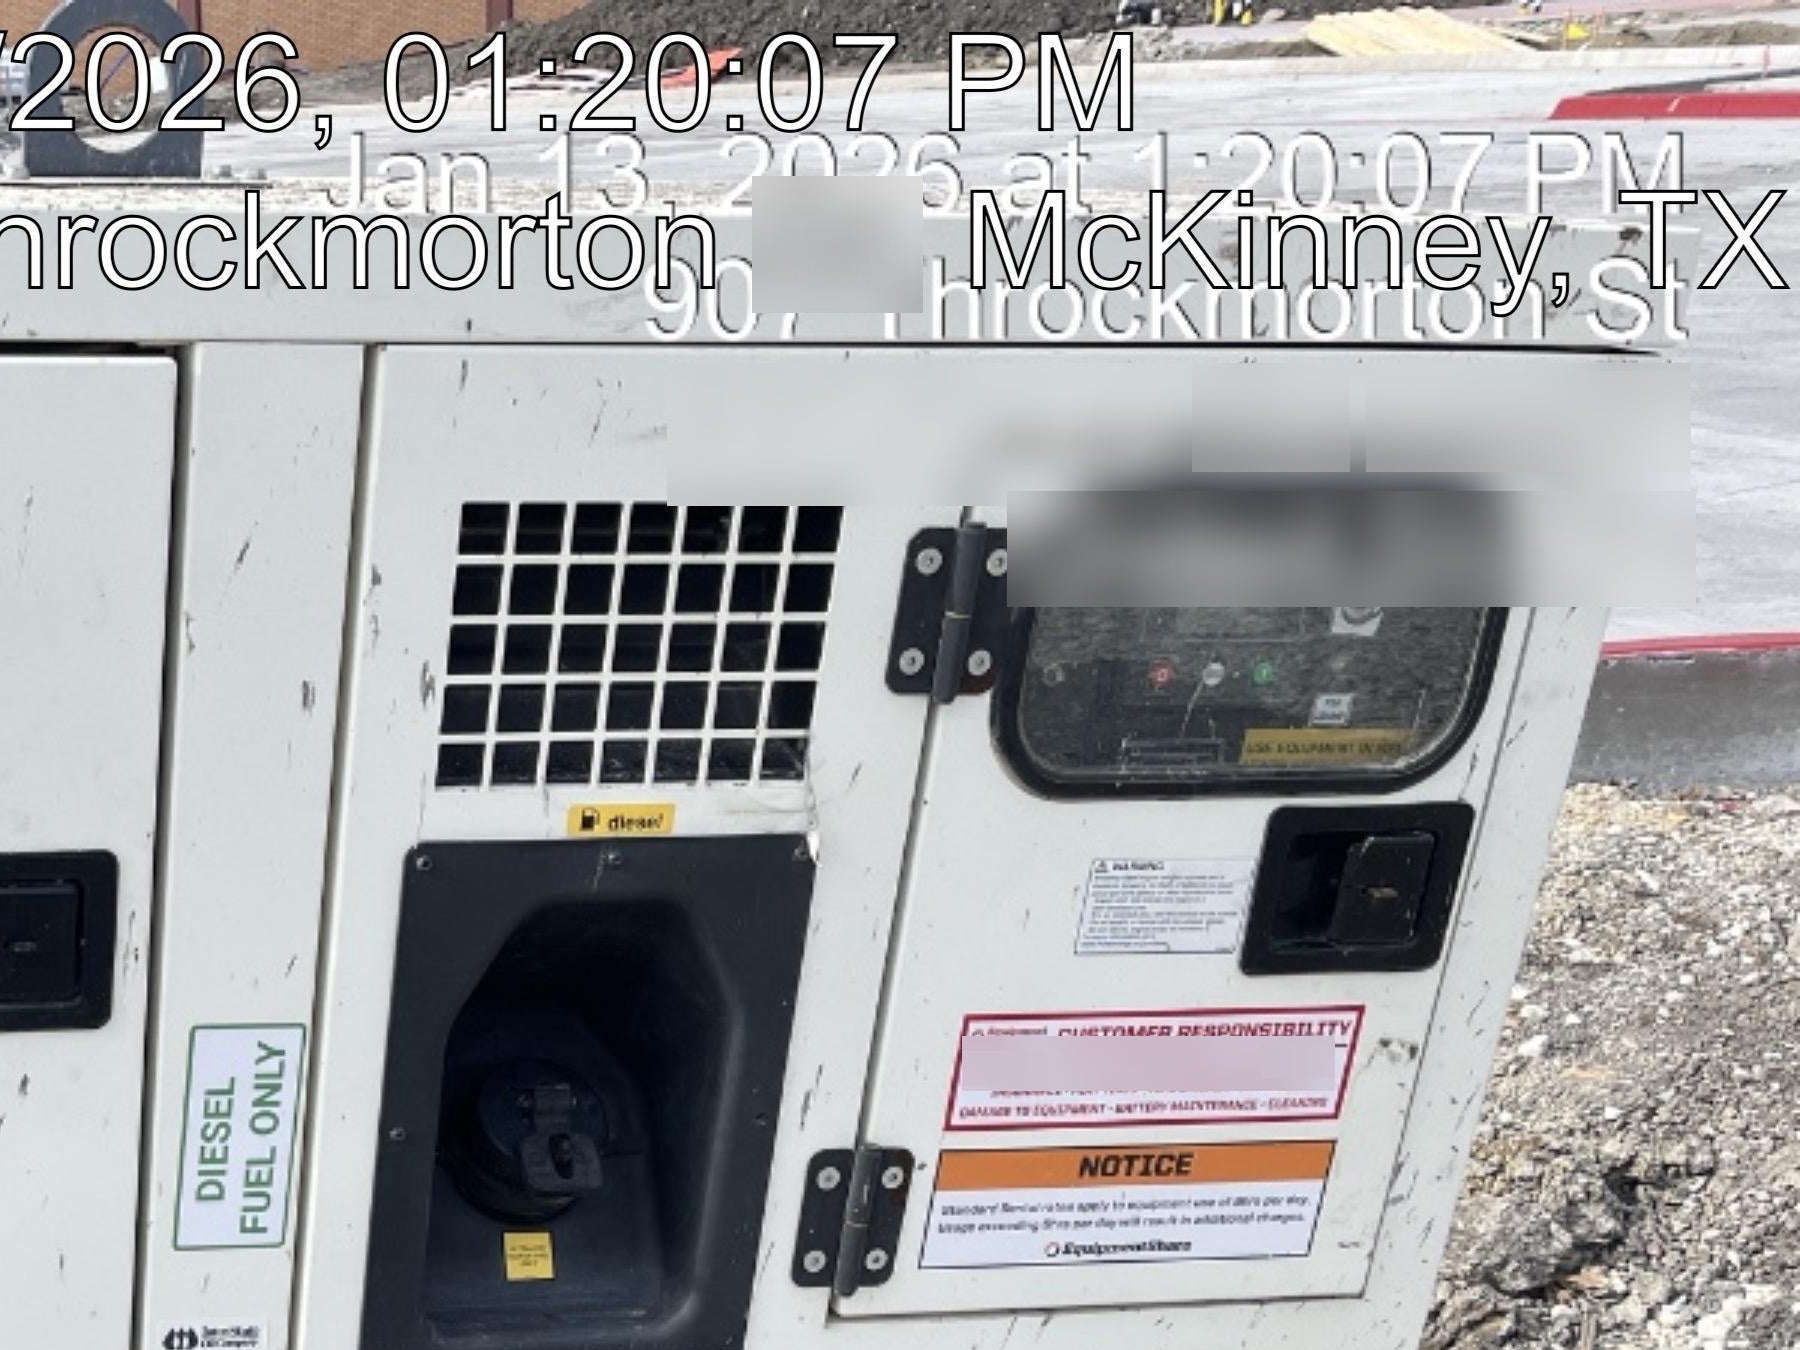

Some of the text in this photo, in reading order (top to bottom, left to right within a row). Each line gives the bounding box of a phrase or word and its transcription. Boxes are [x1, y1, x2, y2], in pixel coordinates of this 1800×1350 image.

[1176, 1019, 1353, 1036] RESPONSIBILITY
[194, 1076, 235, 1202] DIESEL
[239, 1040, 286, 1235] FUEL ONLY
[1079, 1151, 1195, 1179] NOTICE
